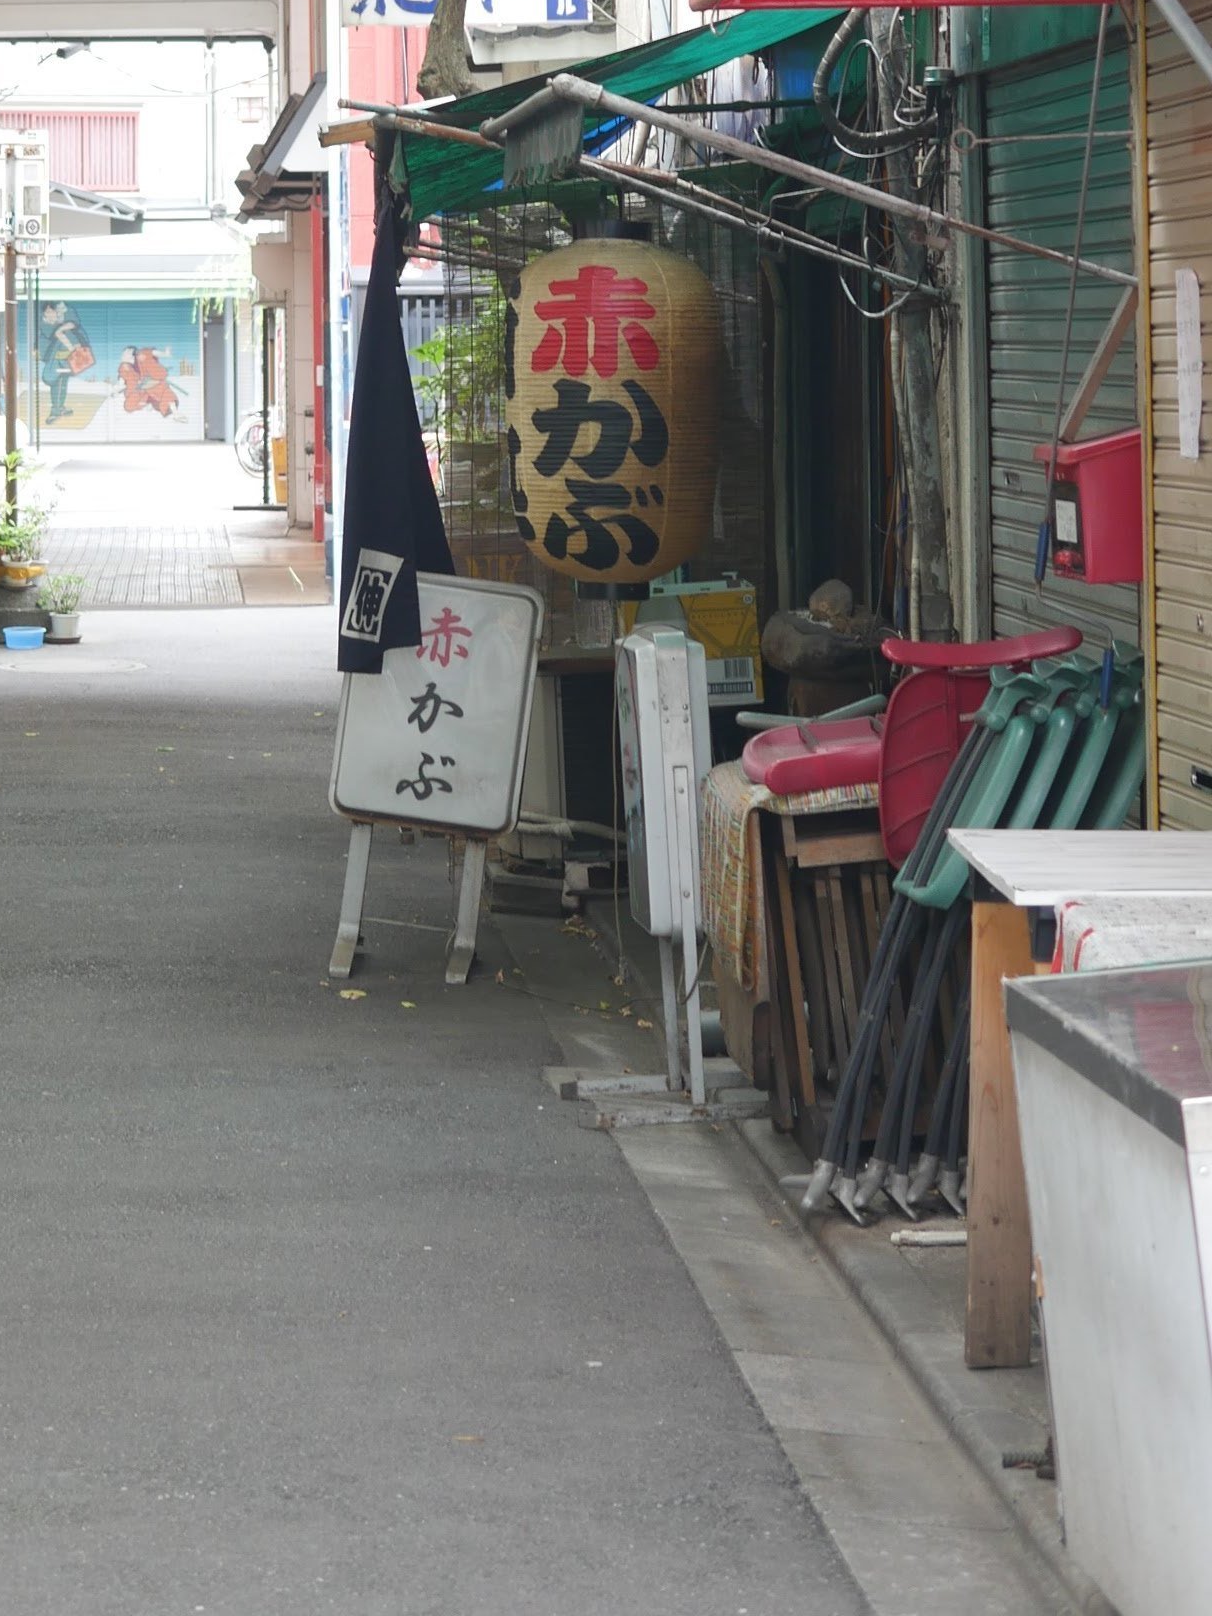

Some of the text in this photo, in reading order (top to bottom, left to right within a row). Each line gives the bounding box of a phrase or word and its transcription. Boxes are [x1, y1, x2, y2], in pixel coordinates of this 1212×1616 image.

[531, 264, 669, 571] 赤かぶ
[396, 607, 473, 801] 赤かぶ
